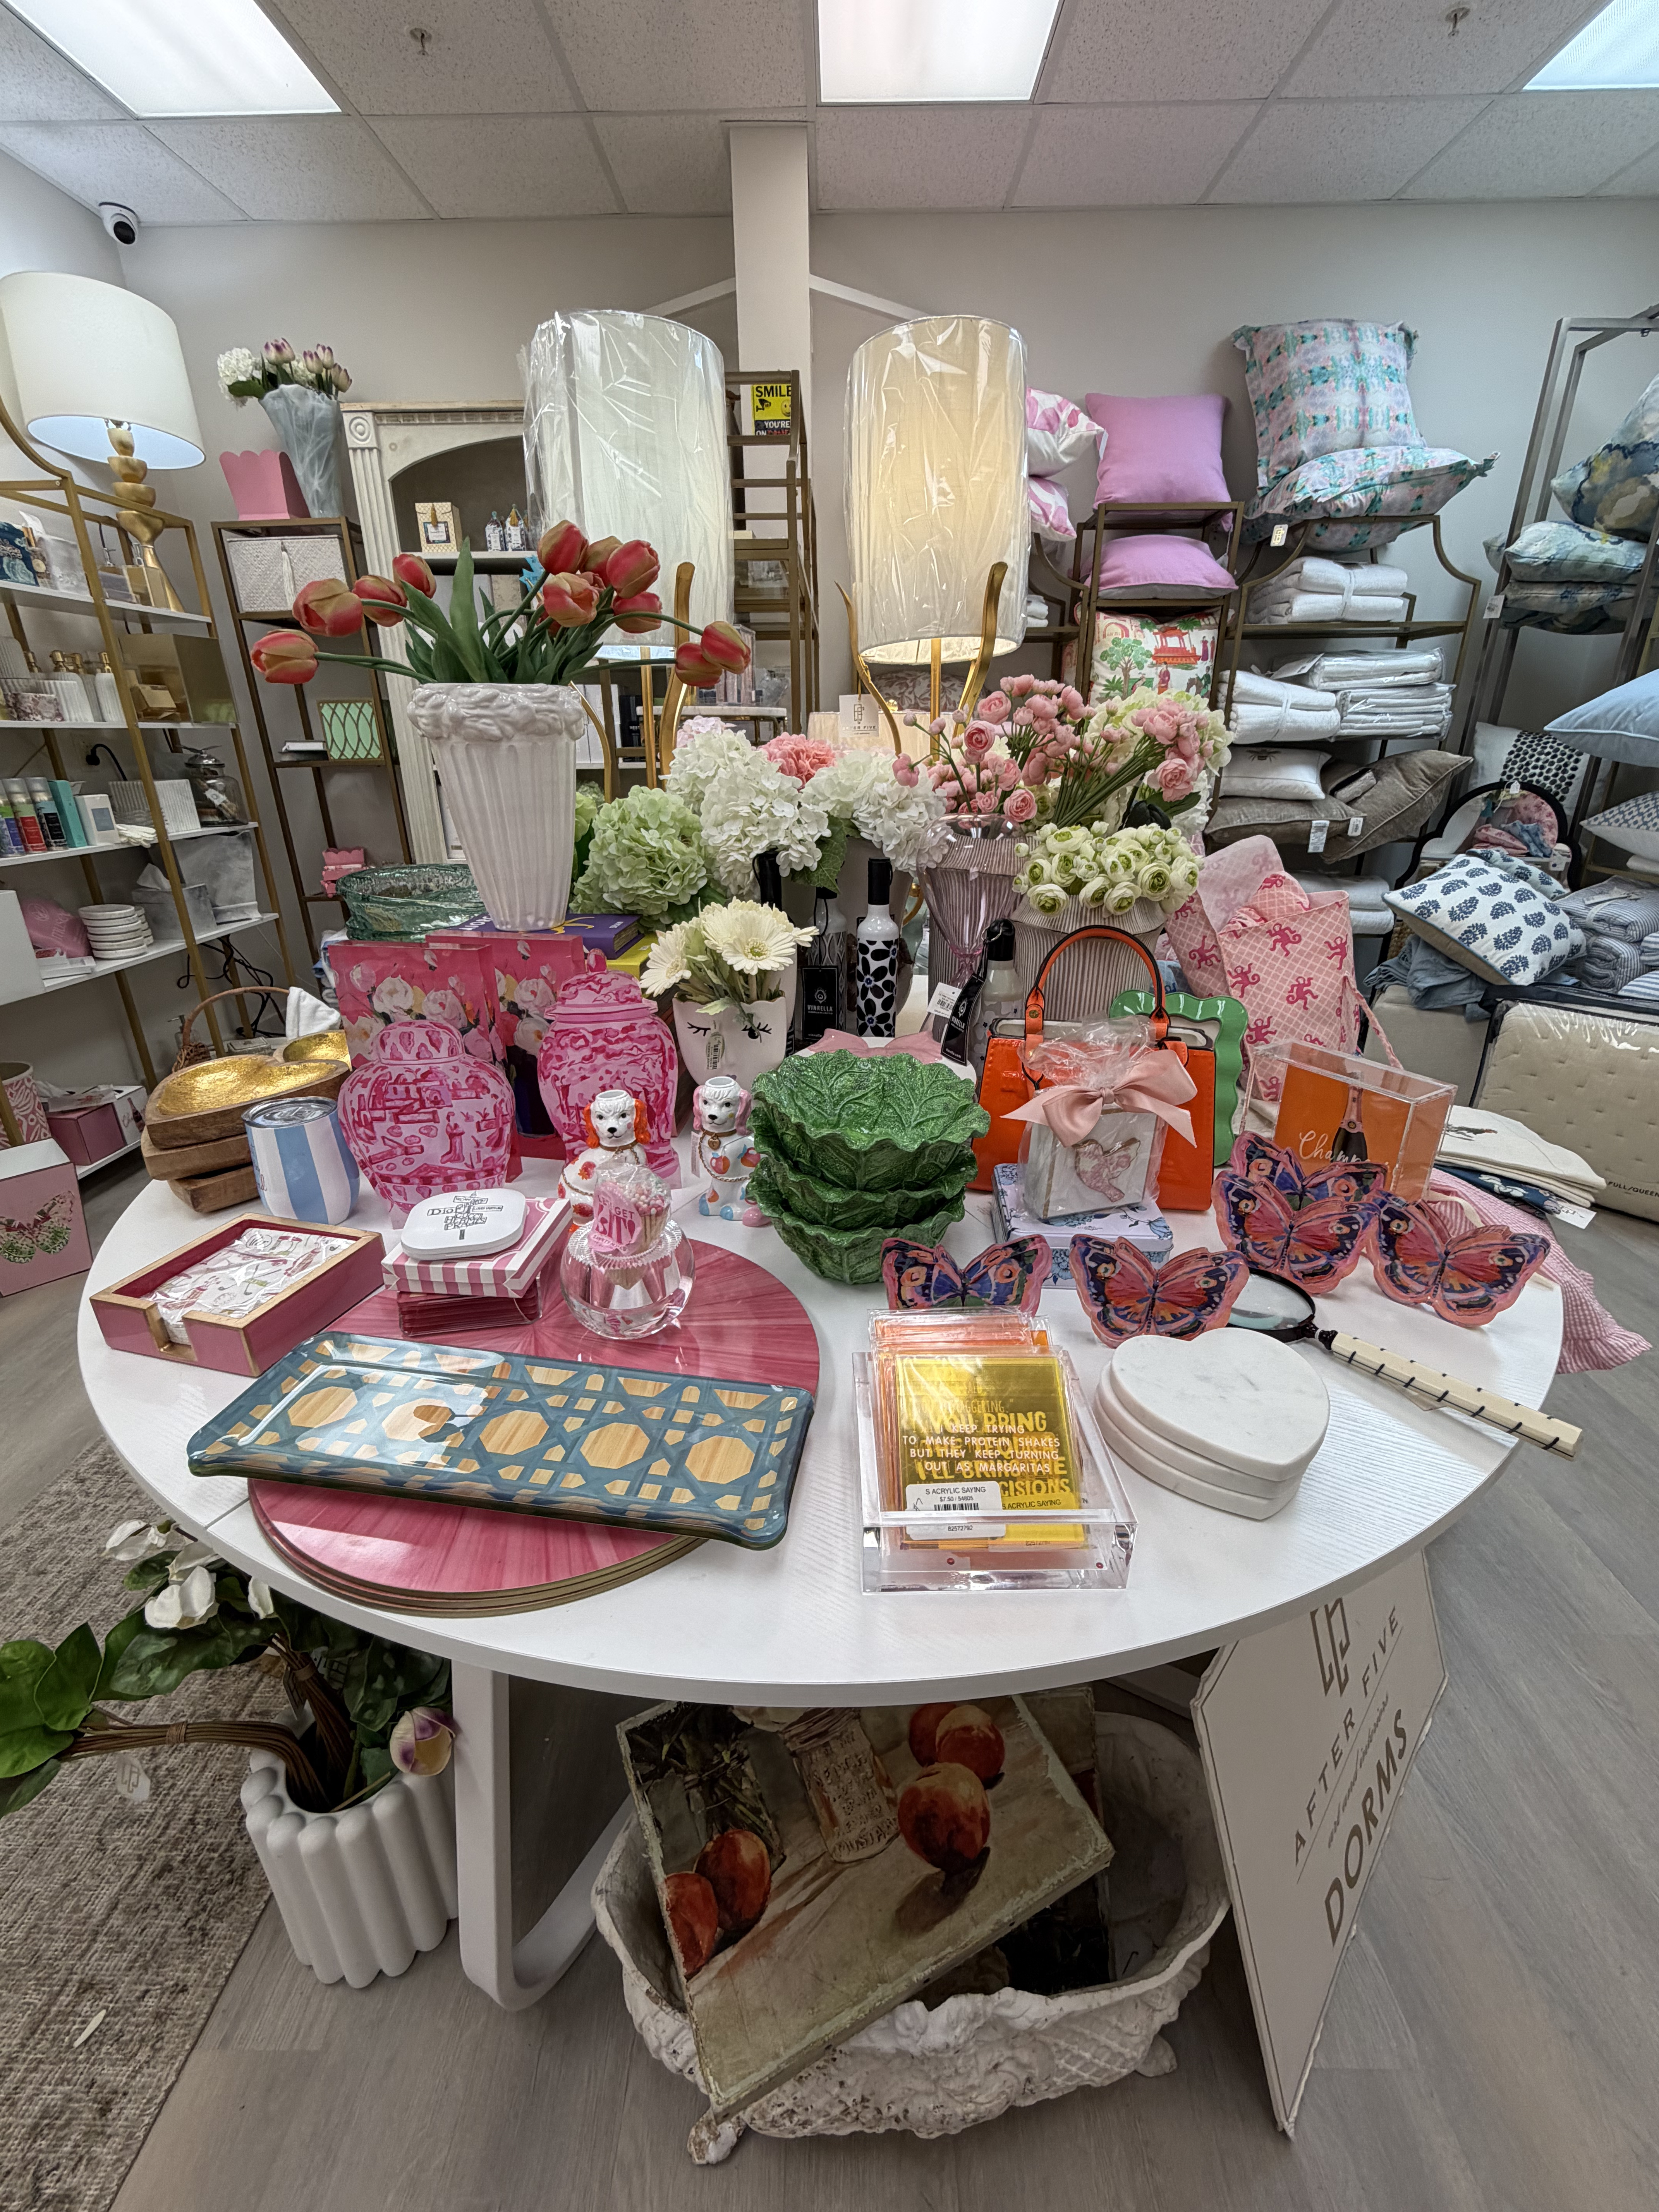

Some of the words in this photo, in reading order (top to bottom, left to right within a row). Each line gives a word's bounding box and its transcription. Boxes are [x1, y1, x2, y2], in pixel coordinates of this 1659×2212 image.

[756, 385, 791, 397] SMILE
[615, 1207, 634, 1219] GET
[952, 1424, 977, 1433] KEEP
[986, 1425, 1025, 1434] TRYING
[903, 1436, 917, 1445] TO
[926, 1436, 955, 1445] MAKE
[965, 1436, 1010, 1446] PROTEIN
[1018, 1437, 1060, 1447] SHAKES
[910, 1449, 930, 1458] BUT
[940, 1449, 966, 1458] THEY
[975, 1449, 1001, 1458] KEEP
[1010, 1450, 1059, 1460] TURNING
[925, 1462, 947, 1471] OUT
[956, 1462, 970, 1471] AS
[979, 1462, 1050, 1472] MARGARITAS
[1007, 1501, 1036, 1509] ACRYLIC
[1295, 1707, 1355, 1867] AFTER
[1361, 1605, 1398, 1698] FIVE
[1342, 1748, 1359, 1813] and
[1324, 1709, 1407, 1948] DORMS
